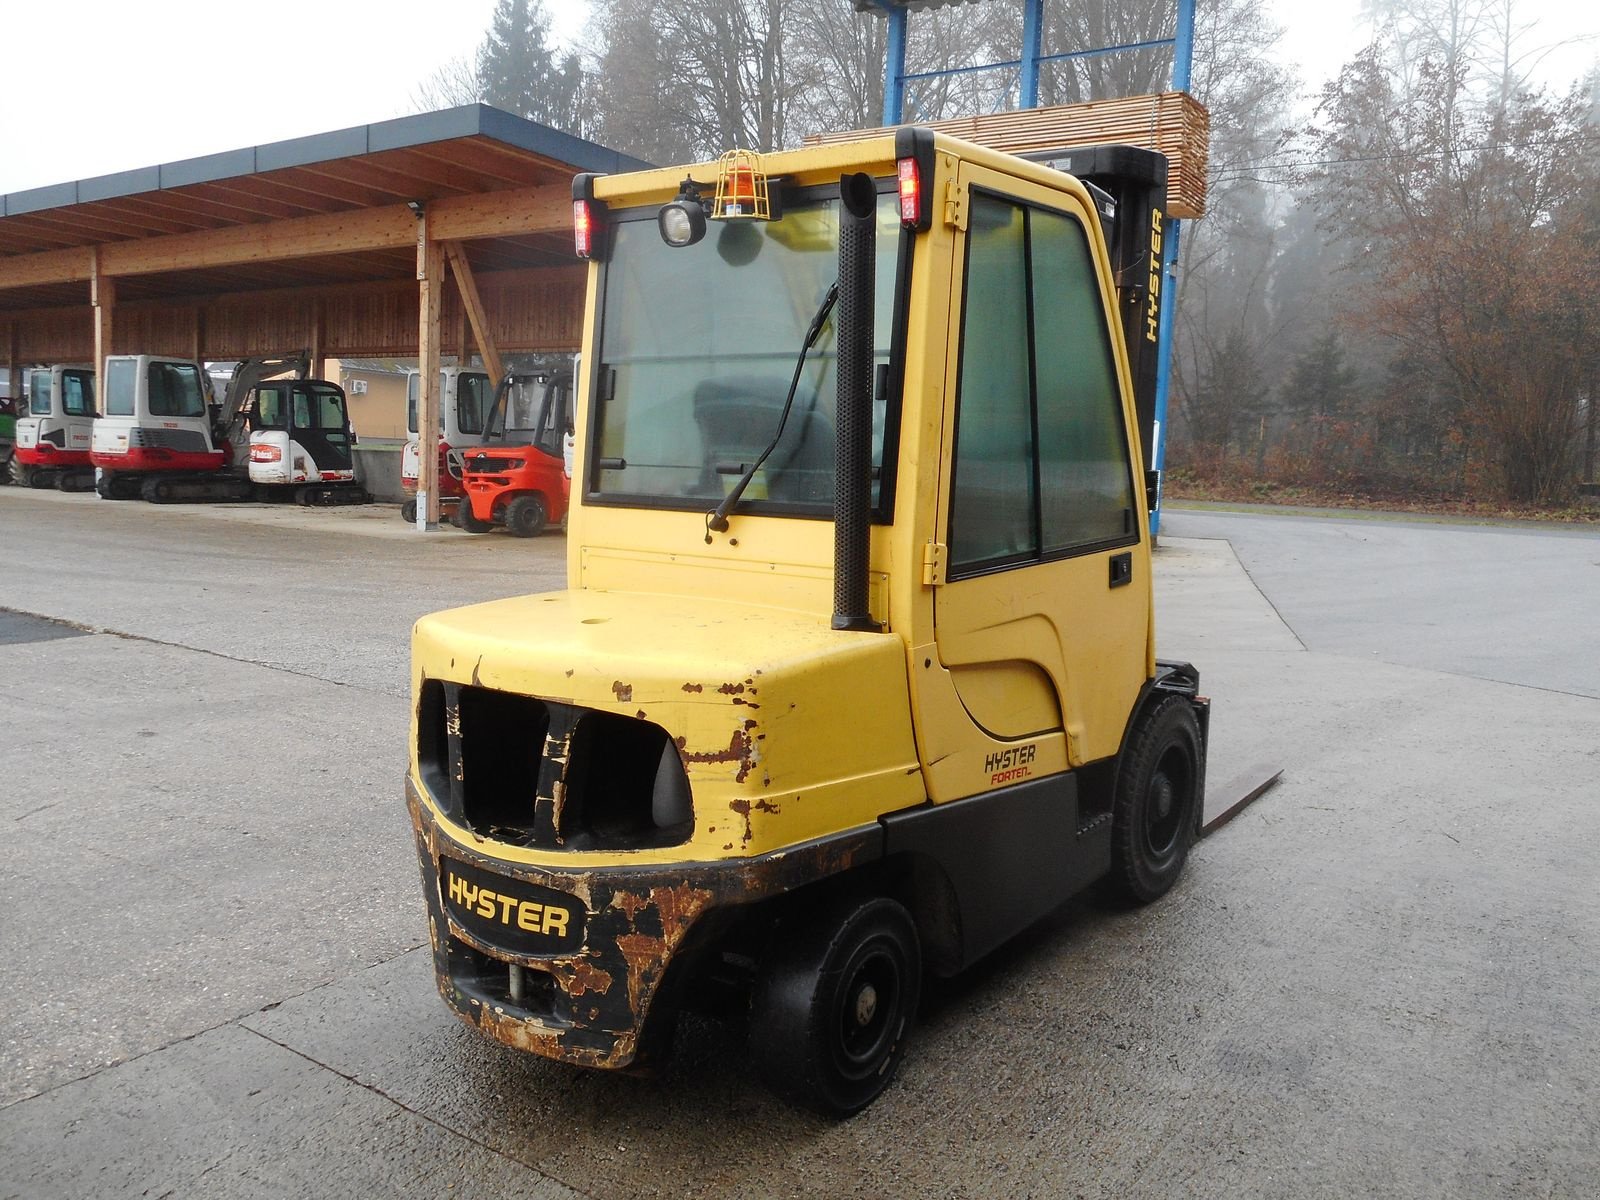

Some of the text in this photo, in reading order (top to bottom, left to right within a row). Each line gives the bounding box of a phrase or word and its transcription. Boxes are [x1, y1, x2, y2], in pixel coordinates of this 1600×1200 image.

[1146, 208, 1162, 342] HYSTER
[984, 744, 1036, 773] HYSTER
[991, 766, 1032, 785] FORTEN
[449, 871, 570, 937] HYSTER
